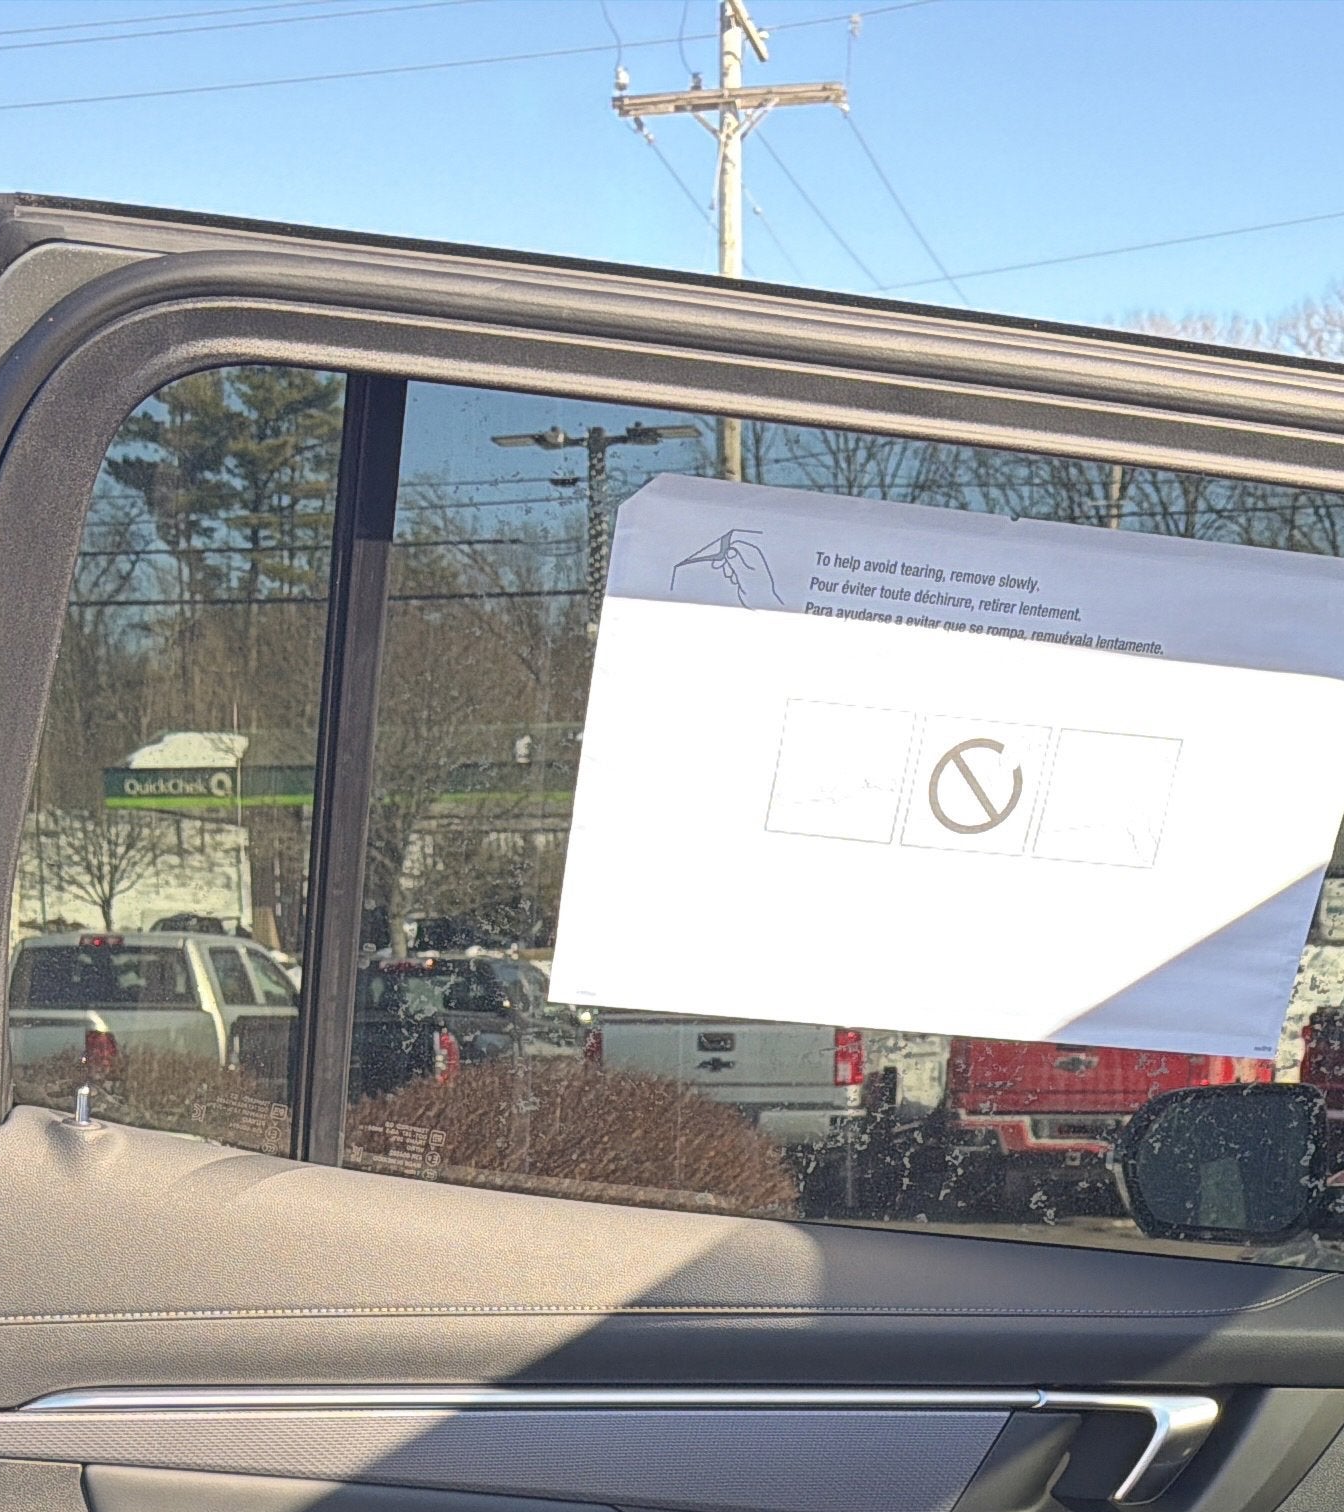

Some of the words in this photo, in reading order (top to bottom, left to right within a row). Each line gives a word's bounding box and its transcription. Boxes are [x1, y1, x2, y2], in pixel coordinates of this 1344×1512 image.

[816, 551, 831, 566] To
[834, 553, 861, 572] help
[863, 559, 898, 575] avoid
[900, 561, 946, 583] tearing,
[949, 570, 996, 587] remove
[998, 573, 1040, 594] slowly.
[809, 576, 839, 593] Pour
[841, 579, 878, 598] éviter
[879, 585, 912, 602] toute
[913, 589, 975, 612] déchirure,
[978, 598, 1017, 614] retirer
[1018, 601, 1082, 622] lentement.
[804, 601, 834, 617] Para
[835, 607, 893, 625] ayudarse
[894, 615, 904, 626] a
[906, 614, 942, 630] evitar
[943, 620, 967, 634] que
[968, 623, 984, 636] se
[986, 625, 1028, 642] rompa,
[1030, 630, 1094, 649] remuévala
[1095, 634, 1164, 656] lentamente.
[123, 777, 208, 796] QuickChek
